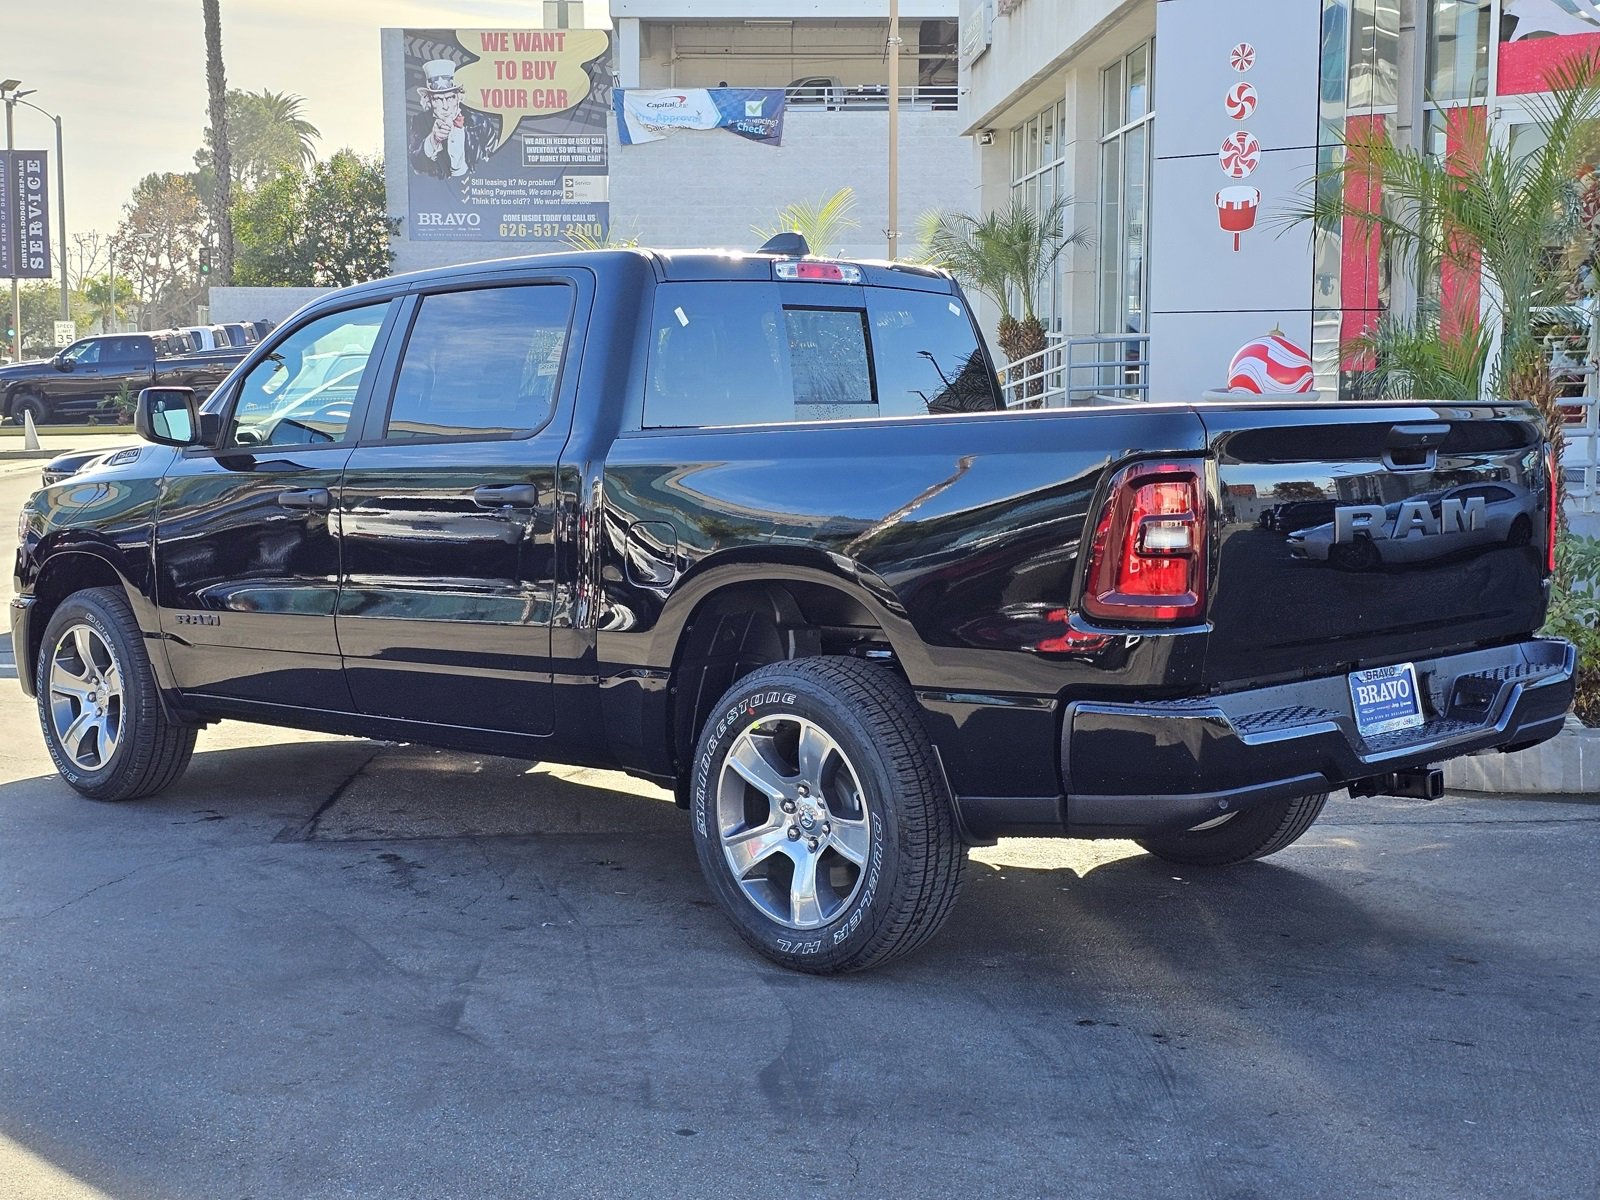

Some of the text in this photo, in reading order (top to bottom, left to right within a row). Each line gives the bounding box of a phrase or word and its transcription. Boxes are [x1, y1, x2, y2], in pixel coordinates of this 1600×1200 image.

[481, 32, 566, 52] WE WANT
[494, 60, 557, 80] TO BUY
[480, 89, 568, 108] YOUR CAR
[737, 122, 767, 135] Check.
[525, 137, 603, 145] WE ARE IN NEED OF USED CAR
[559, 146, 566, 154] SO
[567, 146, 576, 154] WE
[577, 146, 590, 154] WILL
[591, 146, 602, 154] PAY
[471, 178, 556, 188] Still leasing it? No problem!
[471, 188, 494, 196] Making
[552, 189, 563, 197] pay
[472, 197, 490, 205] Think
[490, 197, 500, 205] it's
[512, 197, 531, 205] old??
[533, 197, 544, 205] We
[1, 210, 6, 221] OF
[27, 160, 44, 269] SERVICE
[417, 212, 481, 225] BRAVO
[57, 334, 73, 344] 35
[1334, 497, 1486, 544] RAM
[175, 614, 221, 627] RAM
[1365, 667, 1395, 680] BRAVO
[1356, 679, 1410, 705] BRAVO
[695, 692, 798, 838] BRIDGESTONE
[833, 812, 883, 945] DUELER
[777, 938, 821, 954] H/L
